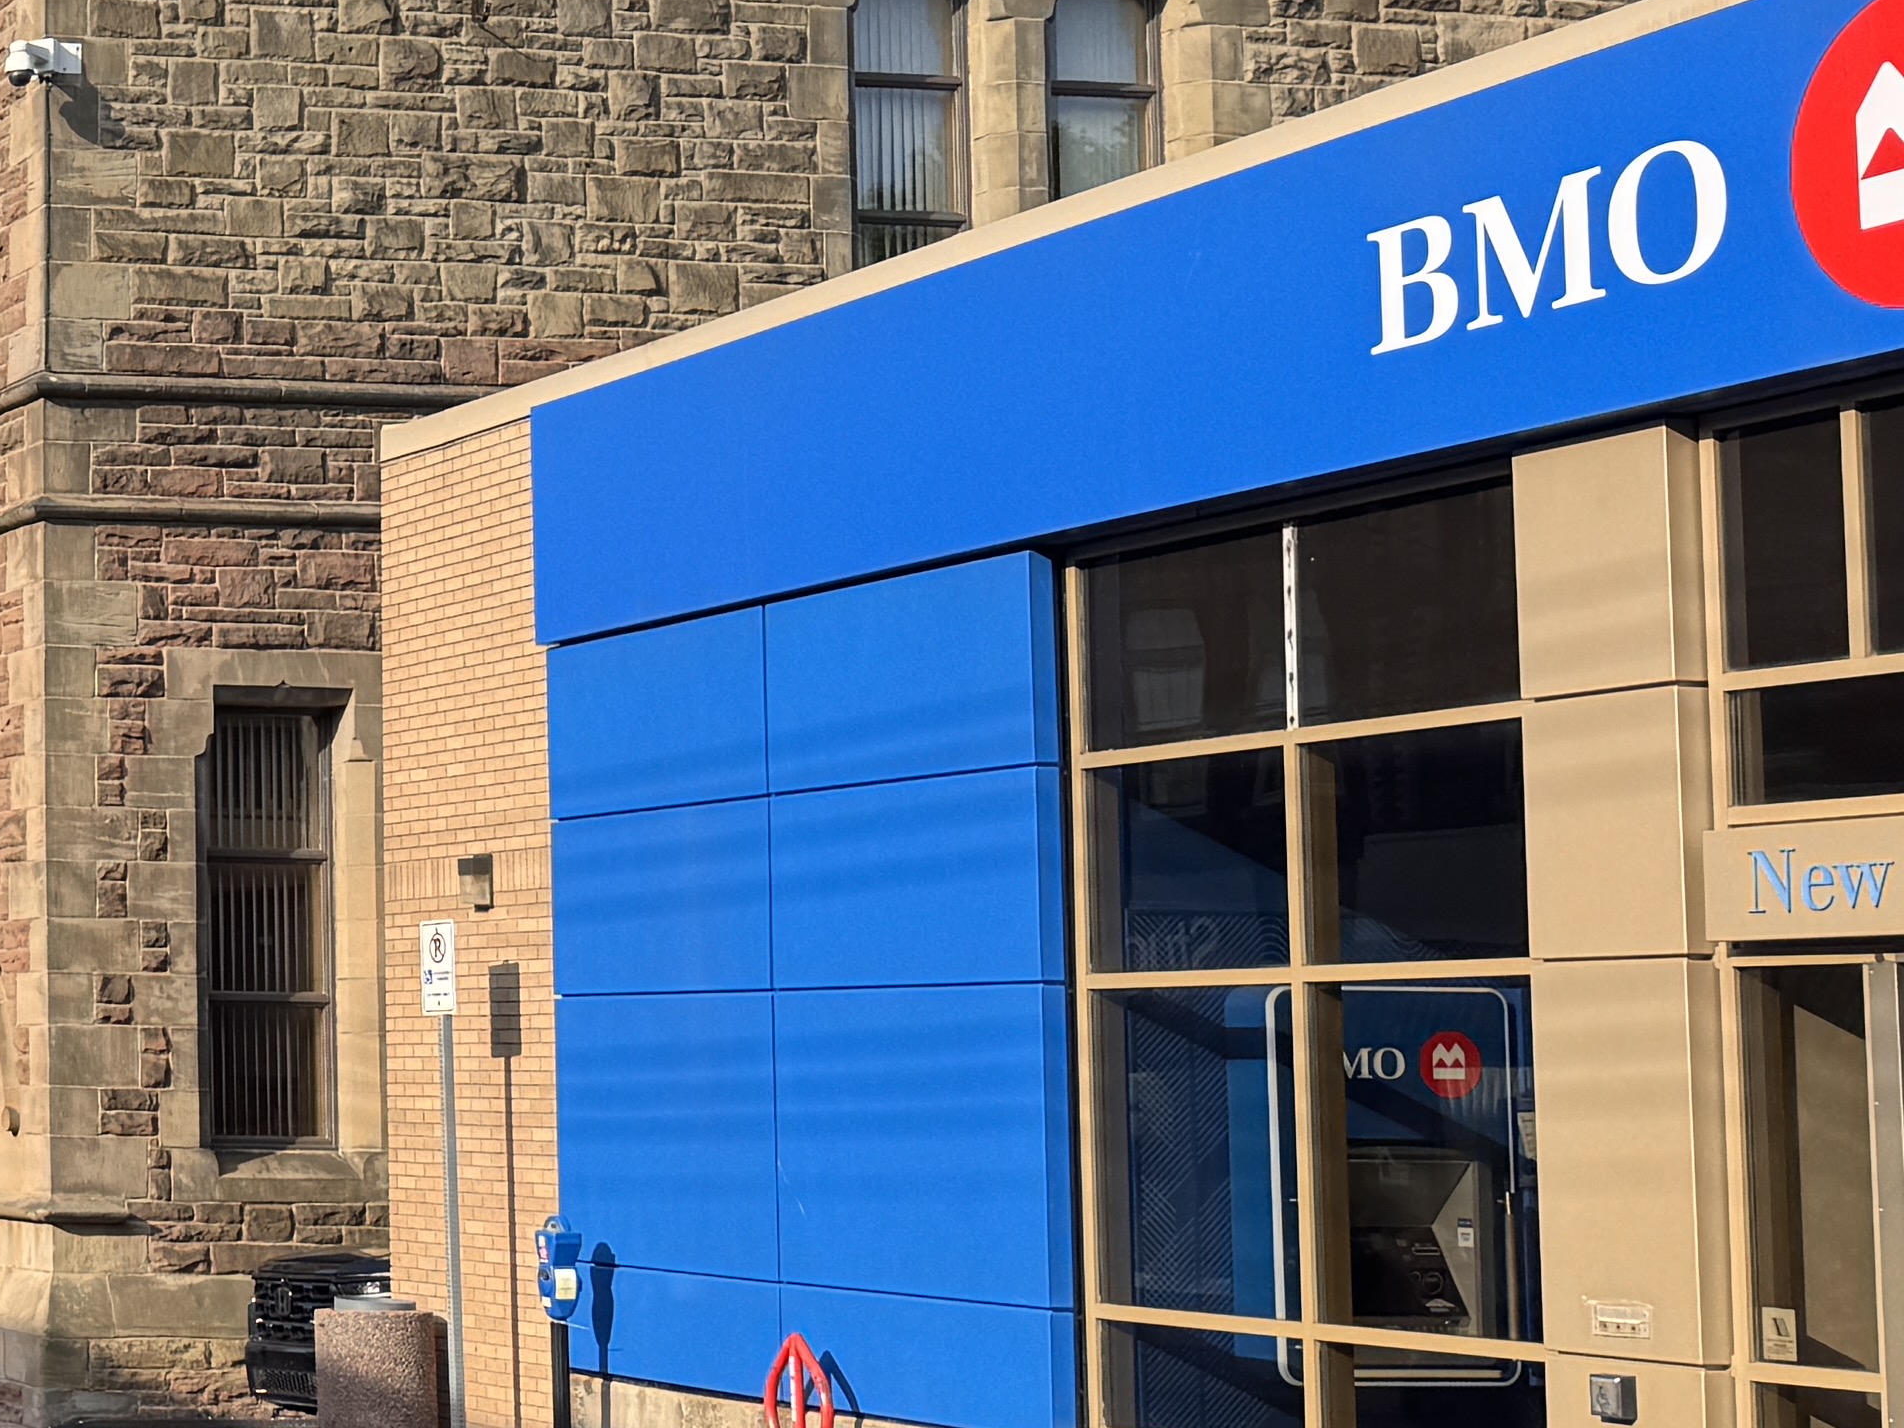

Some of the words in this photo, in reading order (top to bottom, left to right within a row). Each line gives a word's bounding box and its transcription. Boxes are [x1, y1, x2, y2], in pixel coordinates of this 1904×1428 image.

[1366, 139, 1727, 356] BMO
[1747, 848, 1895, 914] New
[1343, 1047, 1406, 1080] MO
